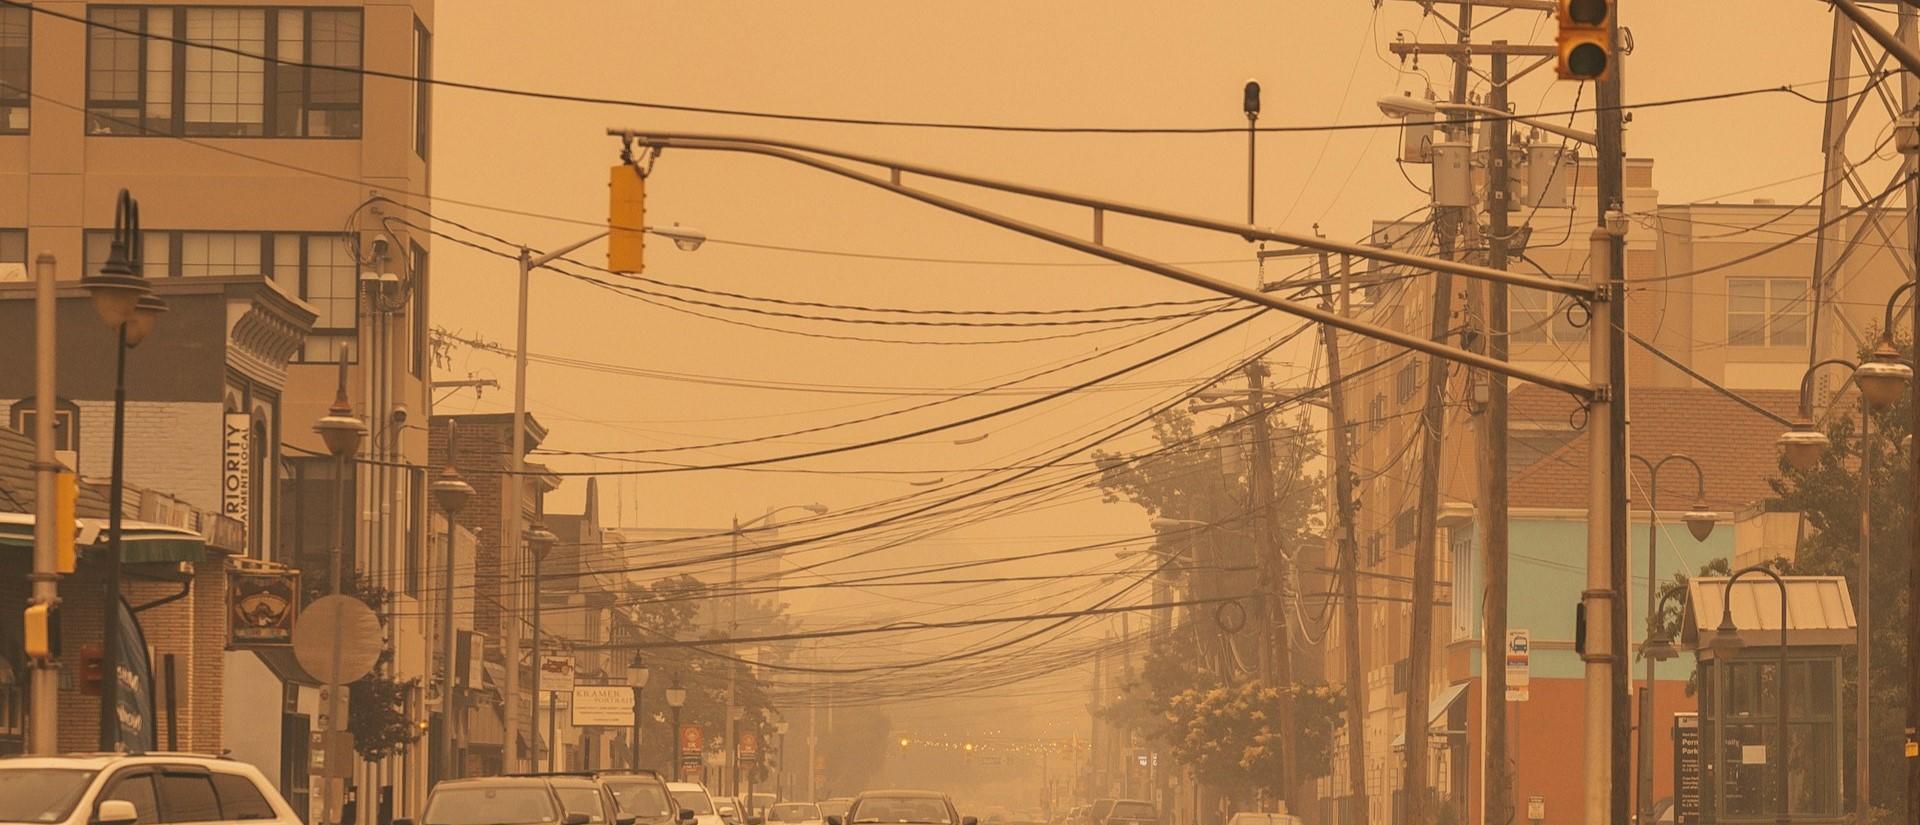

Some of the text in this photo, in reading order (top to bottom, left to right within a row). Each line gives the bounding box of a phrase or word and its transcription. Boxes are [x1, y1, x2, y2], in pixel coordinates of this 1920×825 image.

[226, 424, 240, 514] RIORITY
[240, 428, 248, 522] AYMENTS LOCAL
